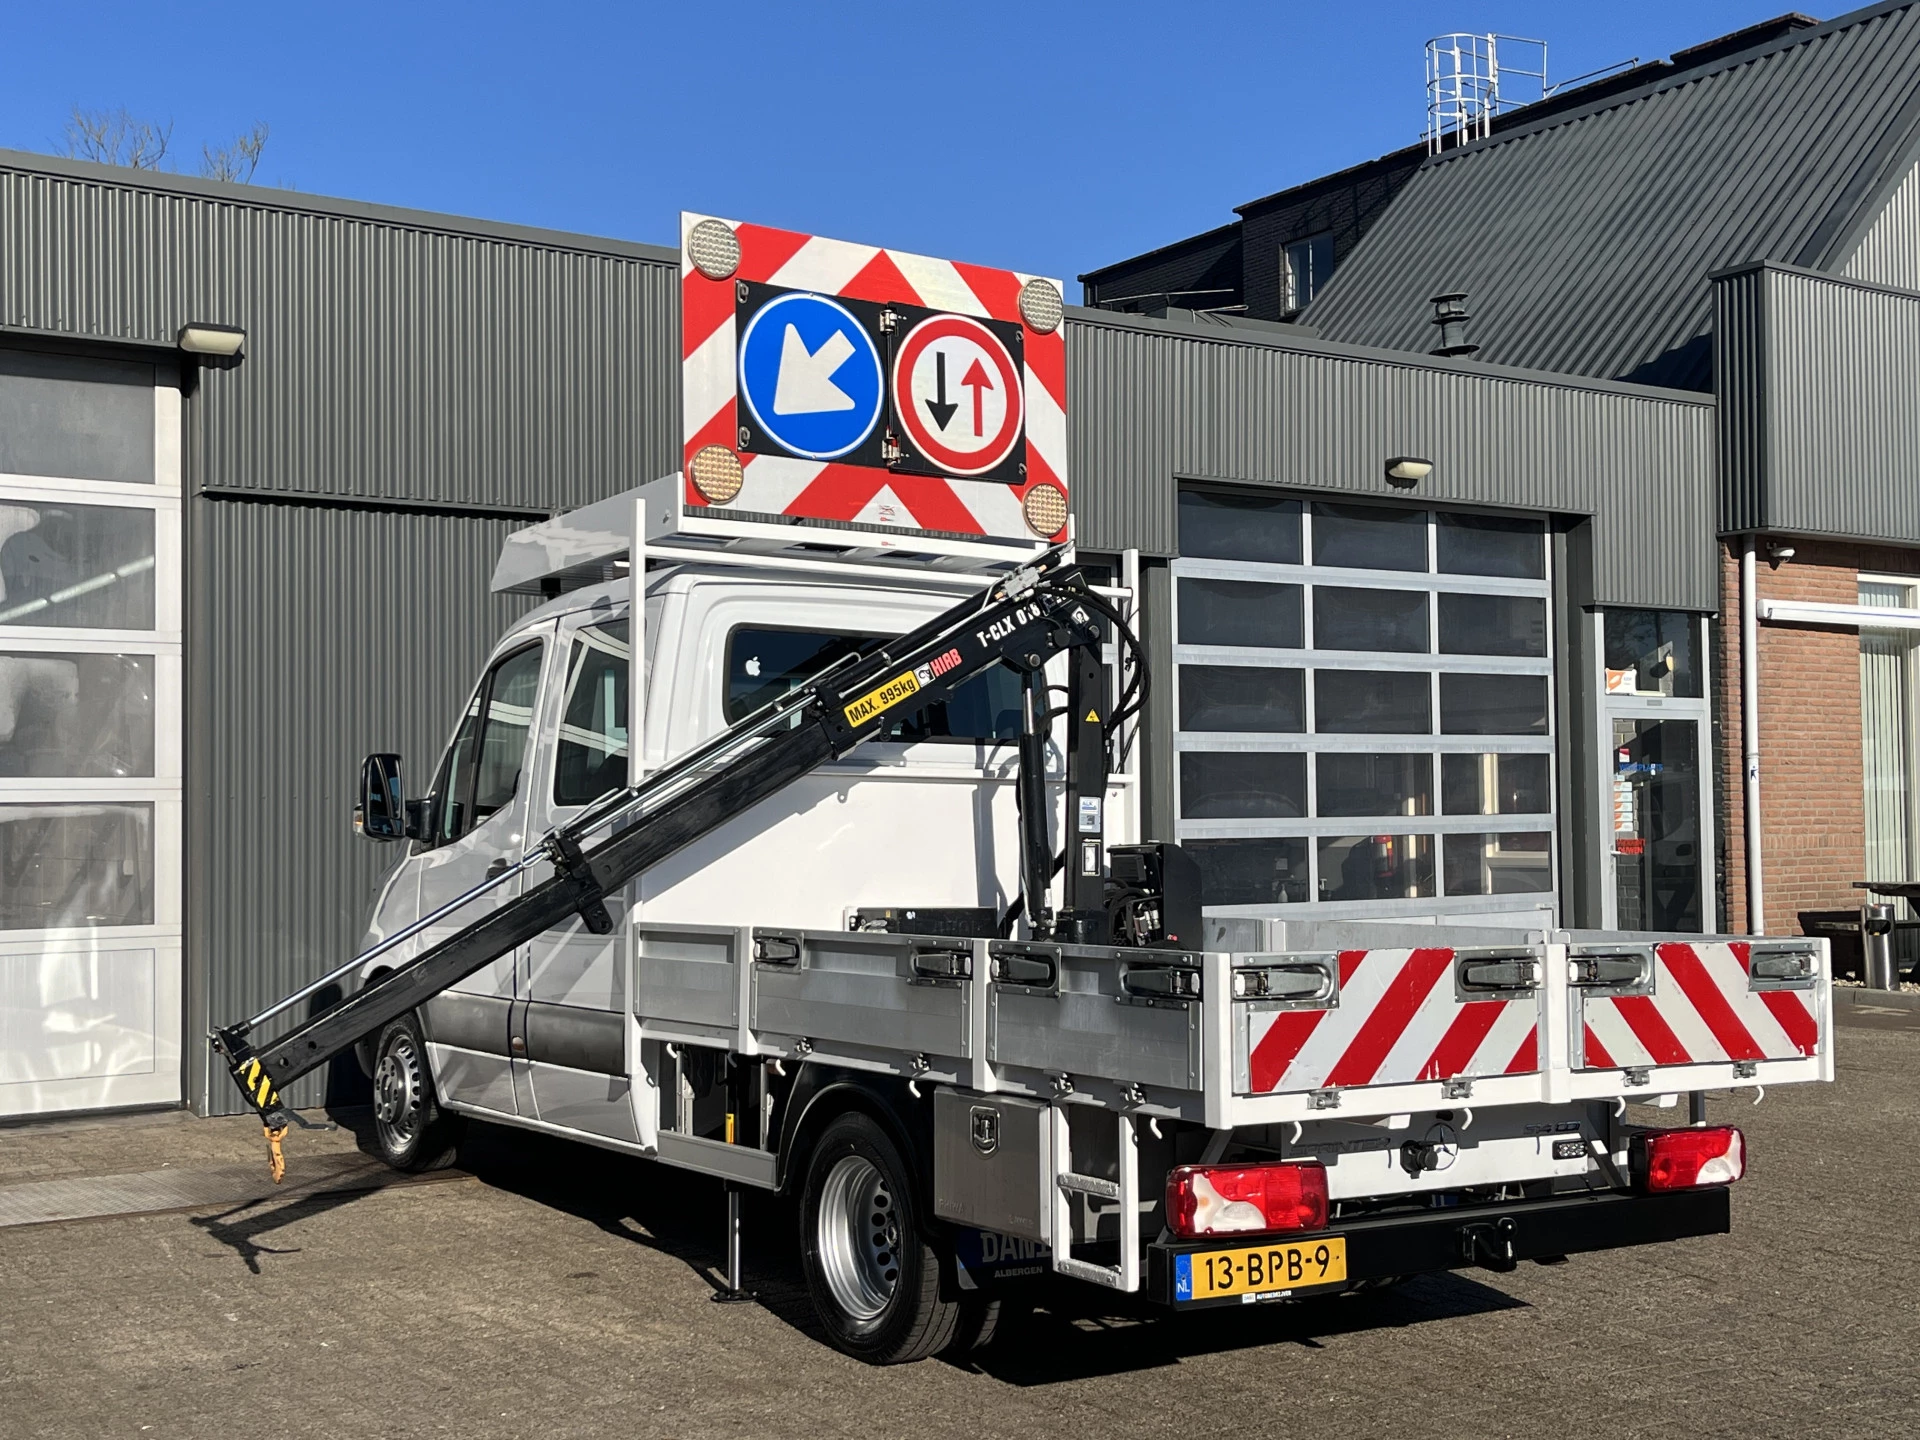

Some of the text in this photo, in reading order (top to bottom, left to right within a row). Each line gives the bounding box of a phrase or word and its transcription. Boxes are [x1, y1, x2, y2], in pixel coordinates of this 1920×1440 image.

[976, 615, 1016, 648] T-CLX
[930, 648, 963, 677] HIAB
[848, 678, 916, 722] MAX. 995kg
[1619, 763, 1664, 772] WKPLATS
[994, 1265, 1043, 1279] ALBERGEN
[1205, 1244, 1330, 1291] 13-BPB-9
[1177, 1281, 1190, 1293] NL
